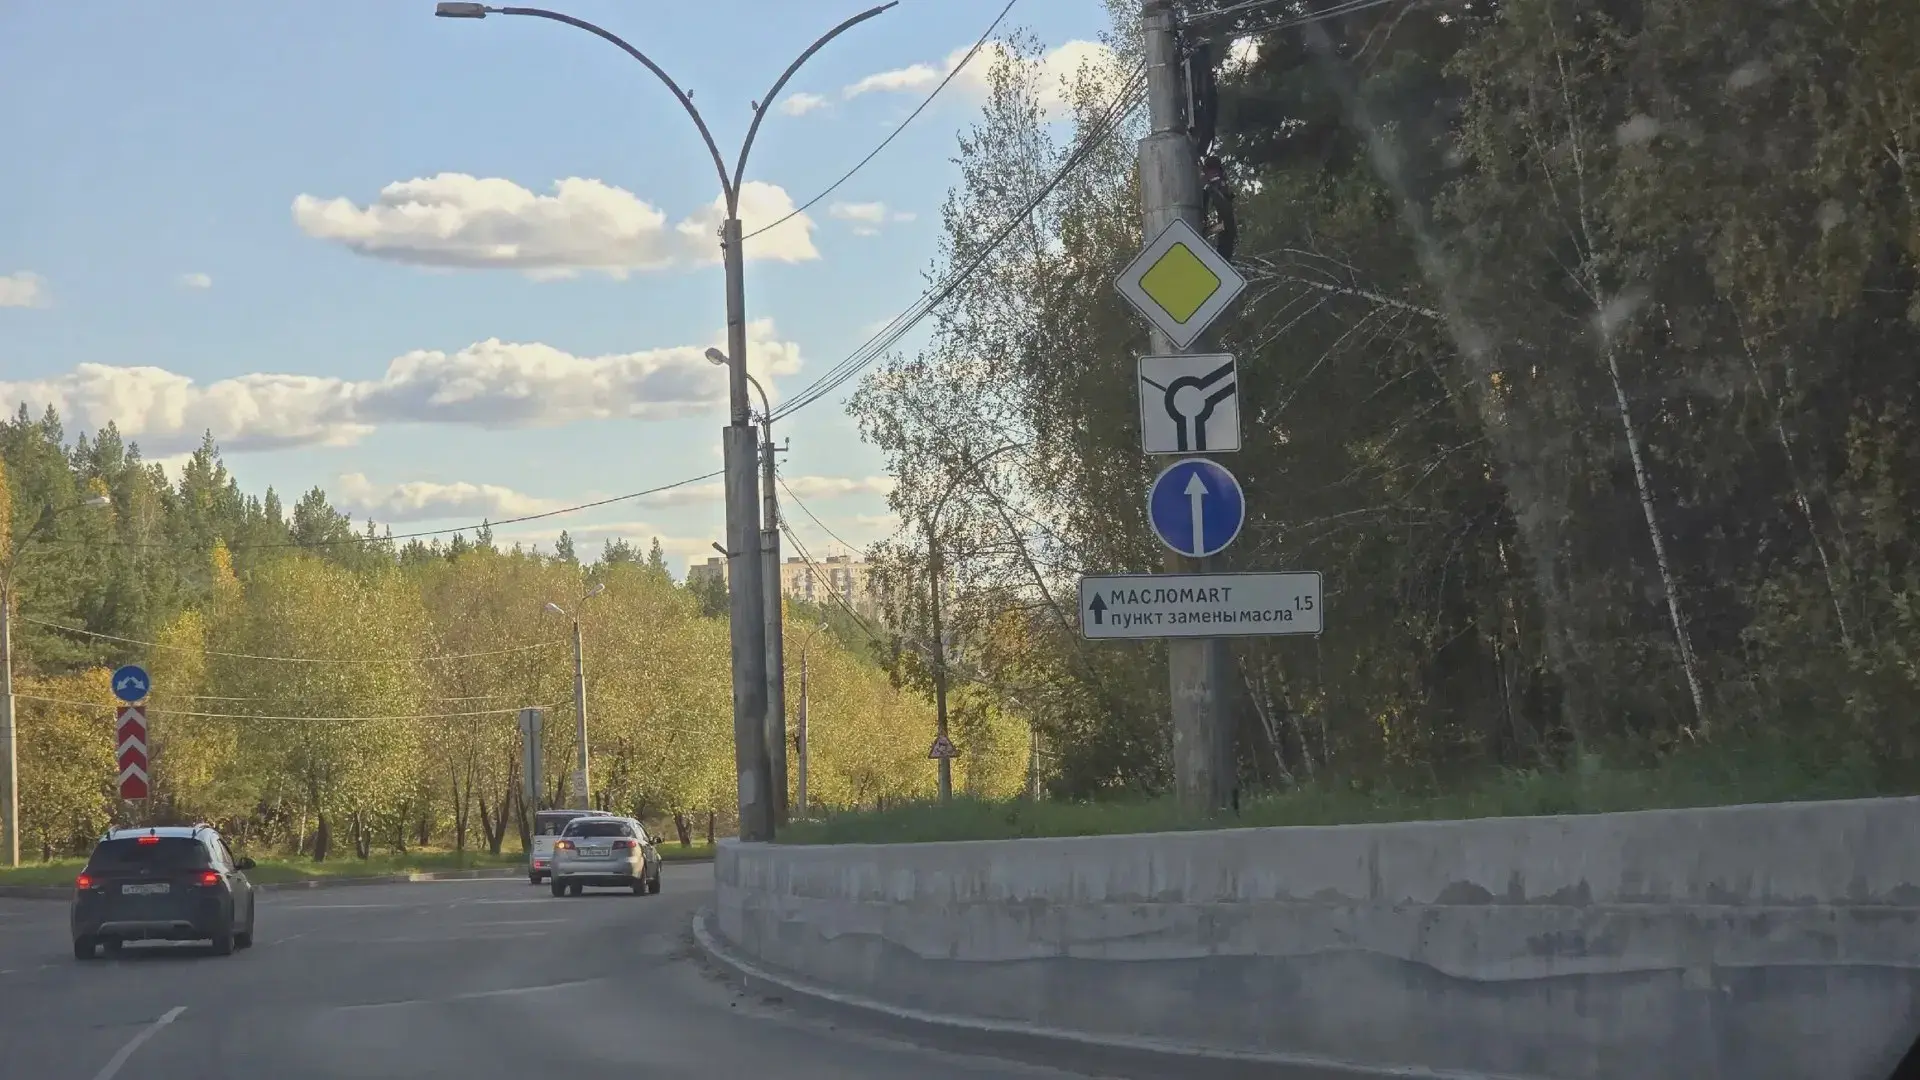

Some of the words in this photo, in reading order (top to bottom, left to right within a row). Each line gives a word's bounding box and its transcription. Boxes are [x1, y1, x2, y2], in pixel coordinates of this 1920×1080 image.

[1111, 611, 1163, 628] пункт
[1167, 608, 1237, 624] замены
[1240, 608, 1293, 622] масла
